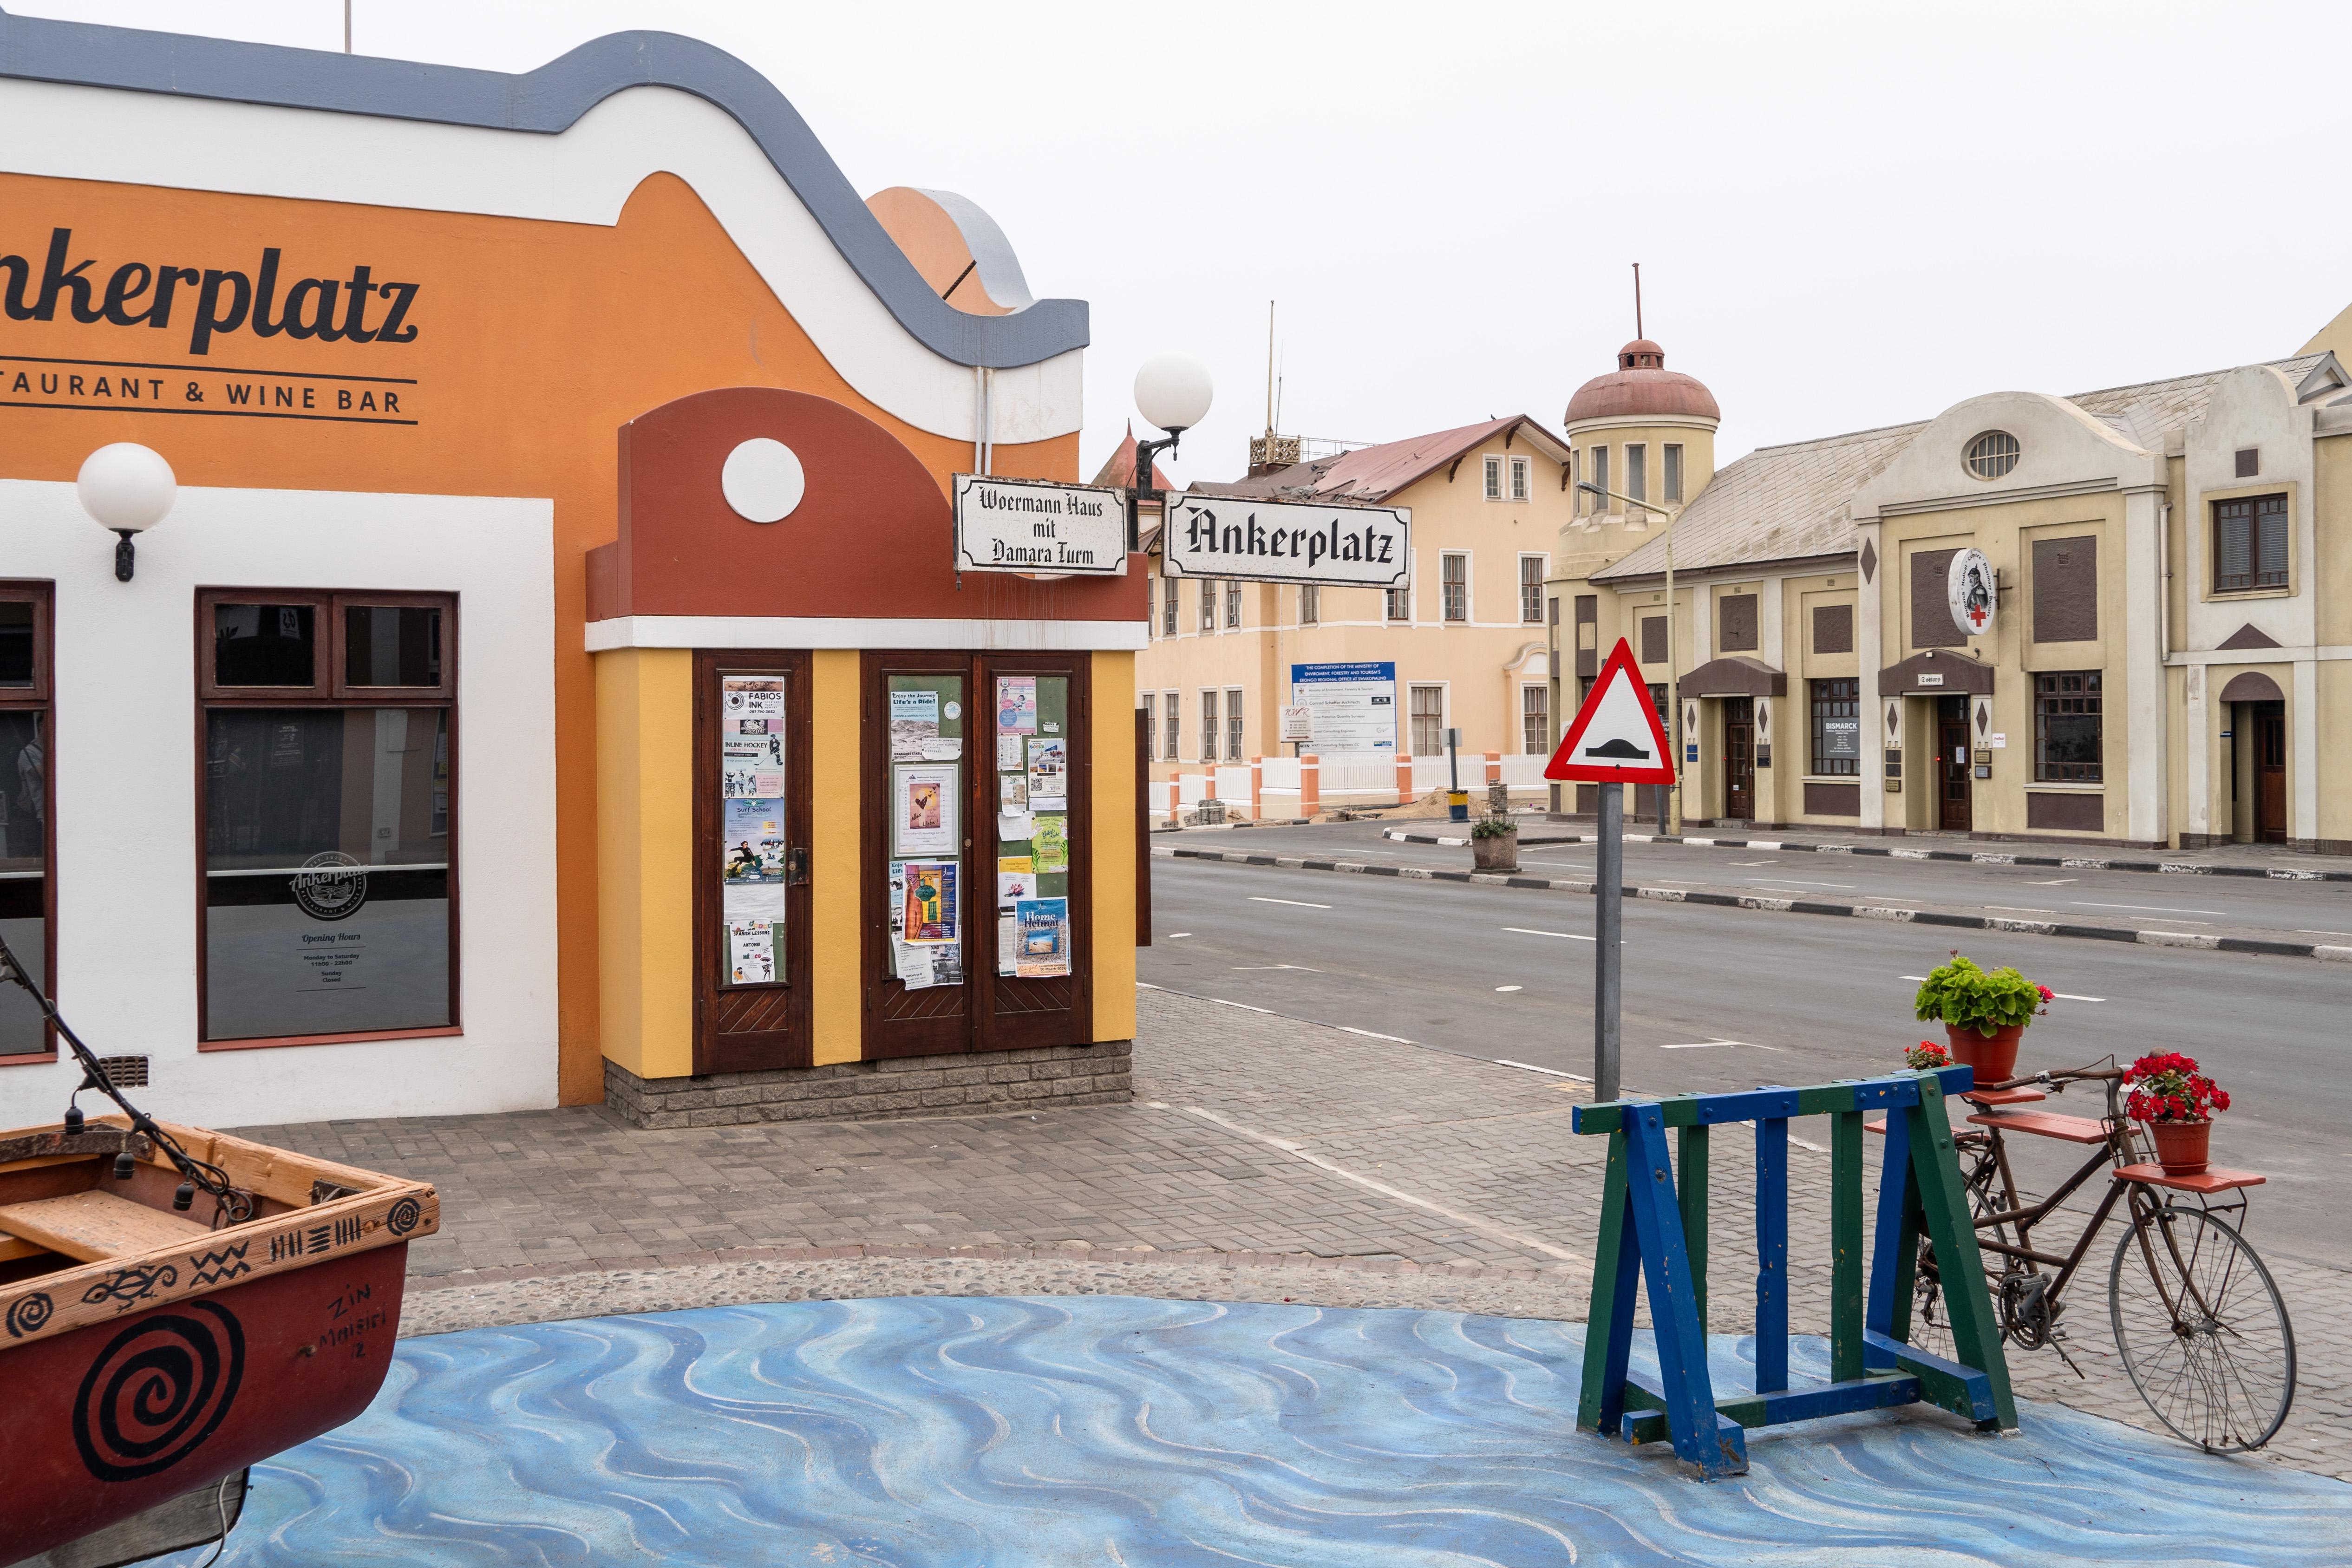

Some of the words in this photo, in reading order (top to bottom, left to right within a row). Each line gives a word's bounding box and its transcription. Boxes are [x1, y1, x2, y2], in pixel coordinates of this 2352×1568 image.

[186, 382, 203, 402] &
[226, 384, 315, 409] WINE
[338, 390, 400, 413] BAR
[979, 486, 1062, 515] Woermann
[1066, 493, 1103, 517] Haus
[1033, 517, 1056, 539] mit
[1184, 506, 1394, 568] Ankerplatz
[992, 537, 1052, 563] Damara
[1057, 542, 1094, 565] Turm
[1961, 592, 1970, 618] Bismarck
[1983, 562, 1992, 590] Pharmacy
[911, 813, 921, 822] Alles
[288, 863, 370, 892] Ankerplatz
[301, 890, 338, 914] RESTAURANT
[347, 892, 360, 907] WINE
[1024, 918, 1058, 928] Heimat
[1025, 911, 1056, 921] Home
[302, 934, 335, 944] Opening
[338, 933, 360, 941] Hours
